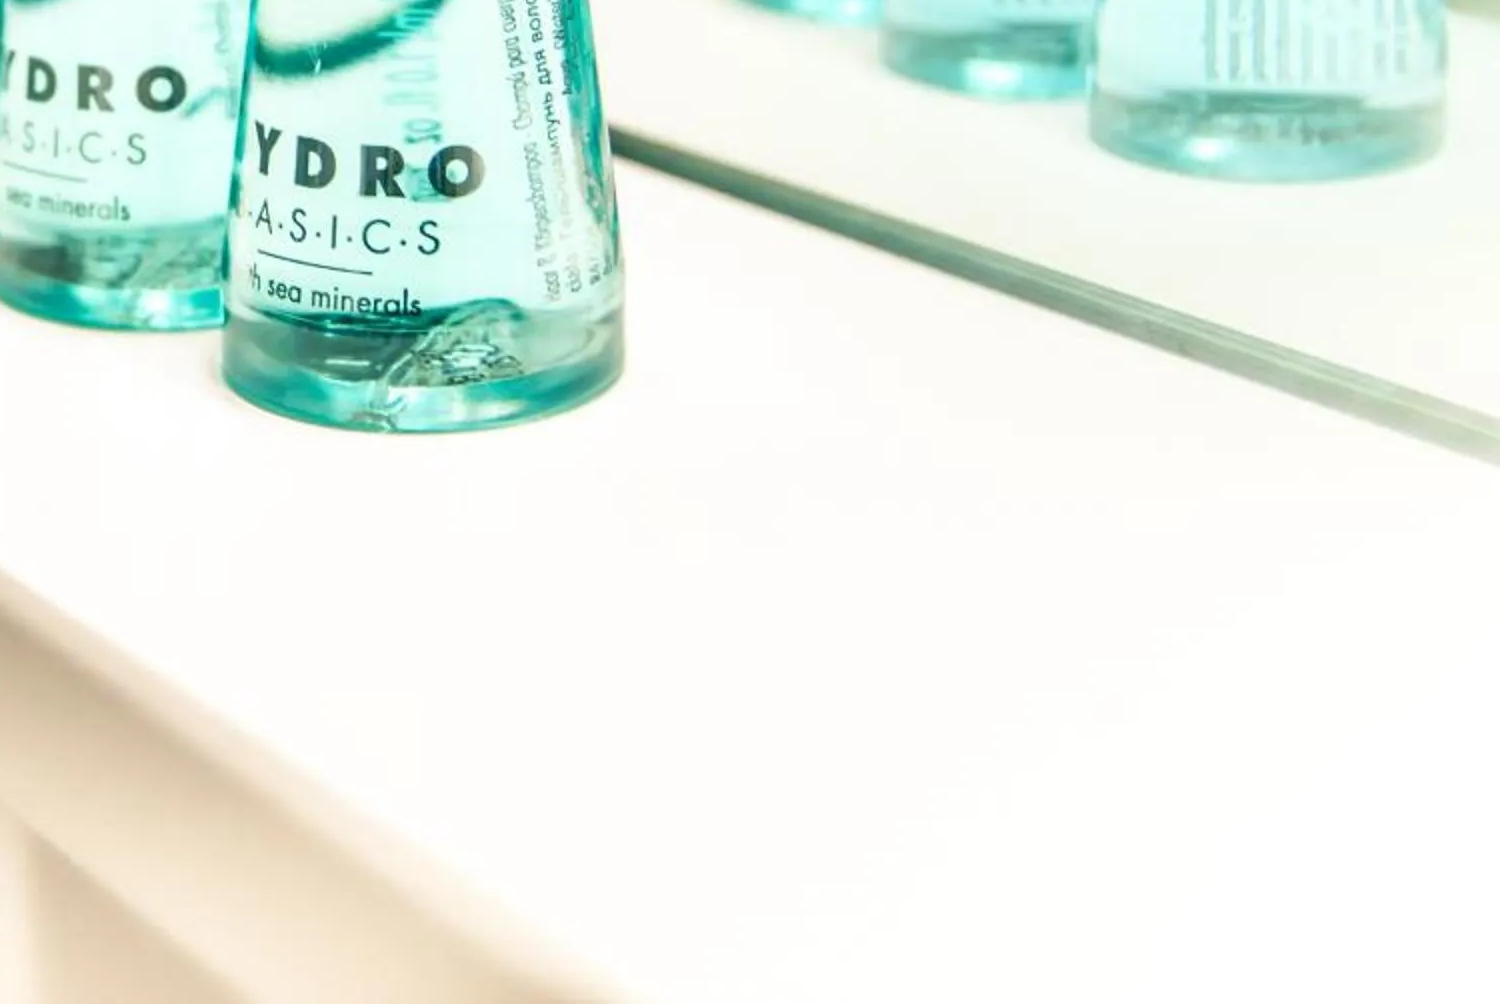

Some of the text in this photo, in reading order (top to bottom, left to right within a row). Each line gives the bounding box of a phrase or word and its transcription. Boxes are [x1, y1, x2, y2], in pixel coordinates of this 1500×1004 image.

[533, 49, 554, 85] для
[38, 195, 131, 222] minerals
[267, 278, 303, 304] sea
[311, 286, 422, 317] minerals
